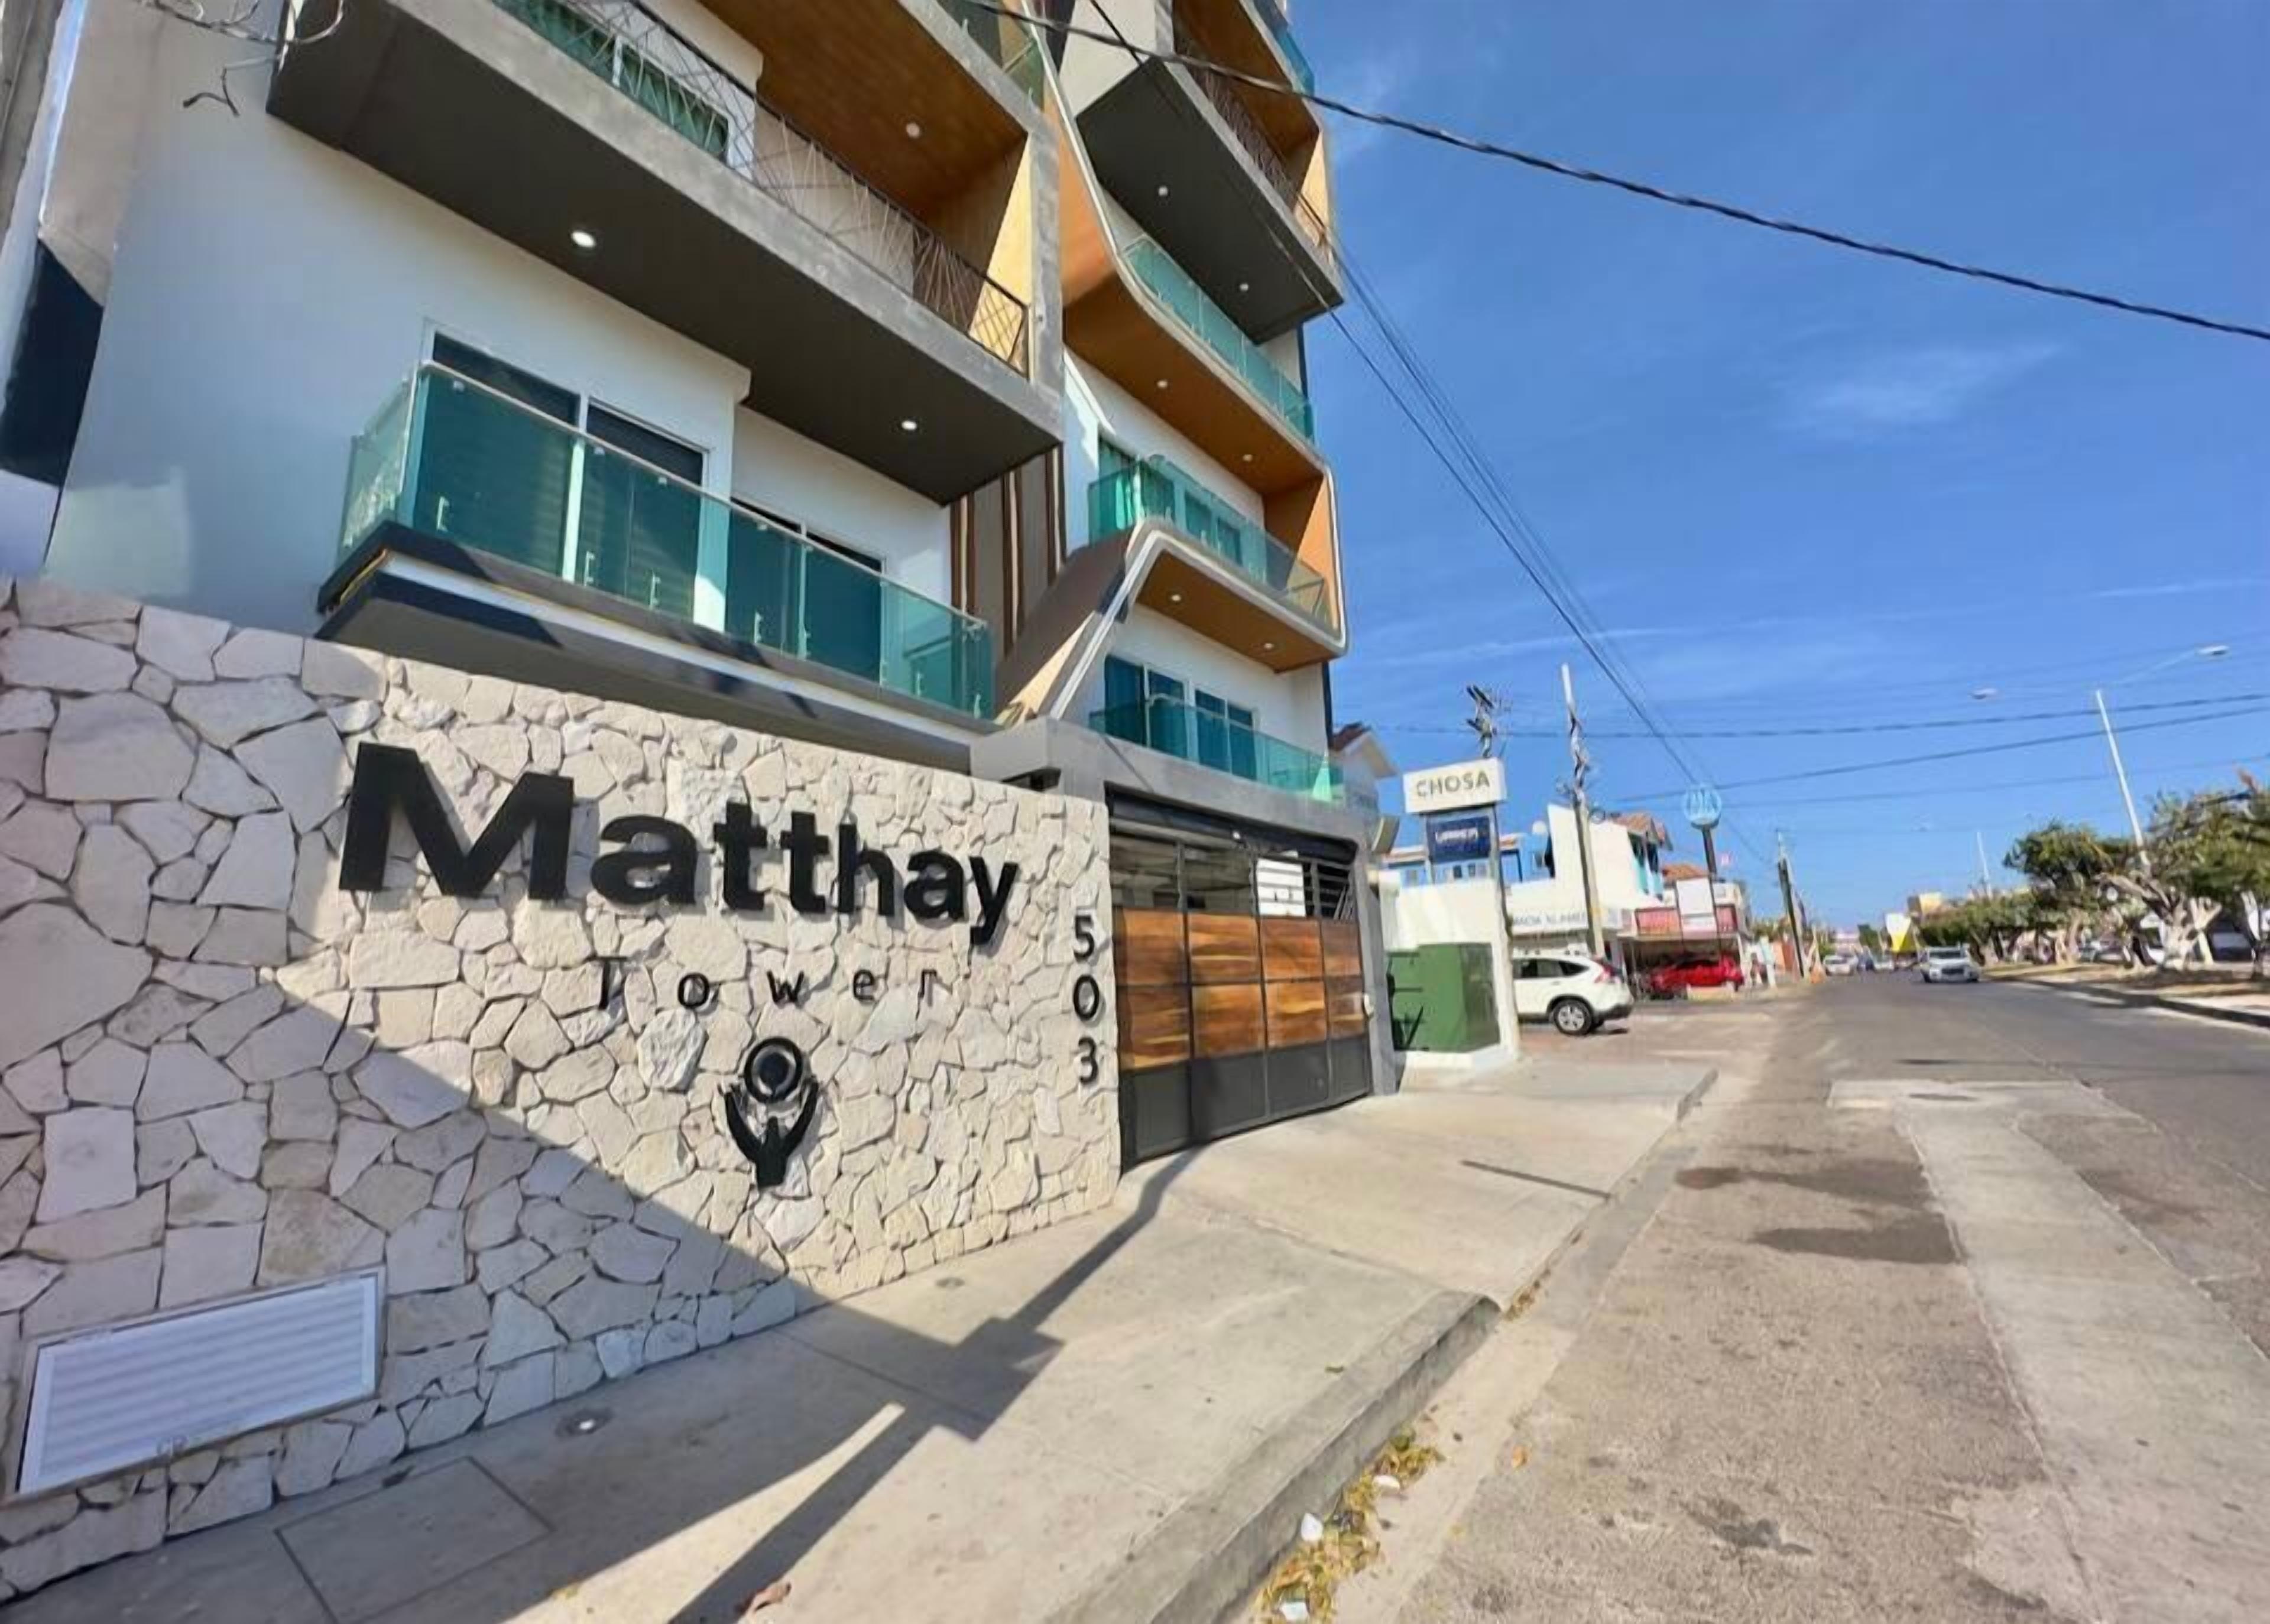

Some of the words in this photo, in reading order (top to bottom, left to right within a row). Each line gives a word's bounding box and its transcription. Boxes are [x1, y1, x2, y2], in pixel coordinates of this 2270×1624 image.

[1416, 771, 1490, 797] CHOSA
[338, 741, 1019, 946] Matthay
[590, 955, 938, 1010] Tower
[1073, 915, 1100, 1084] 503
